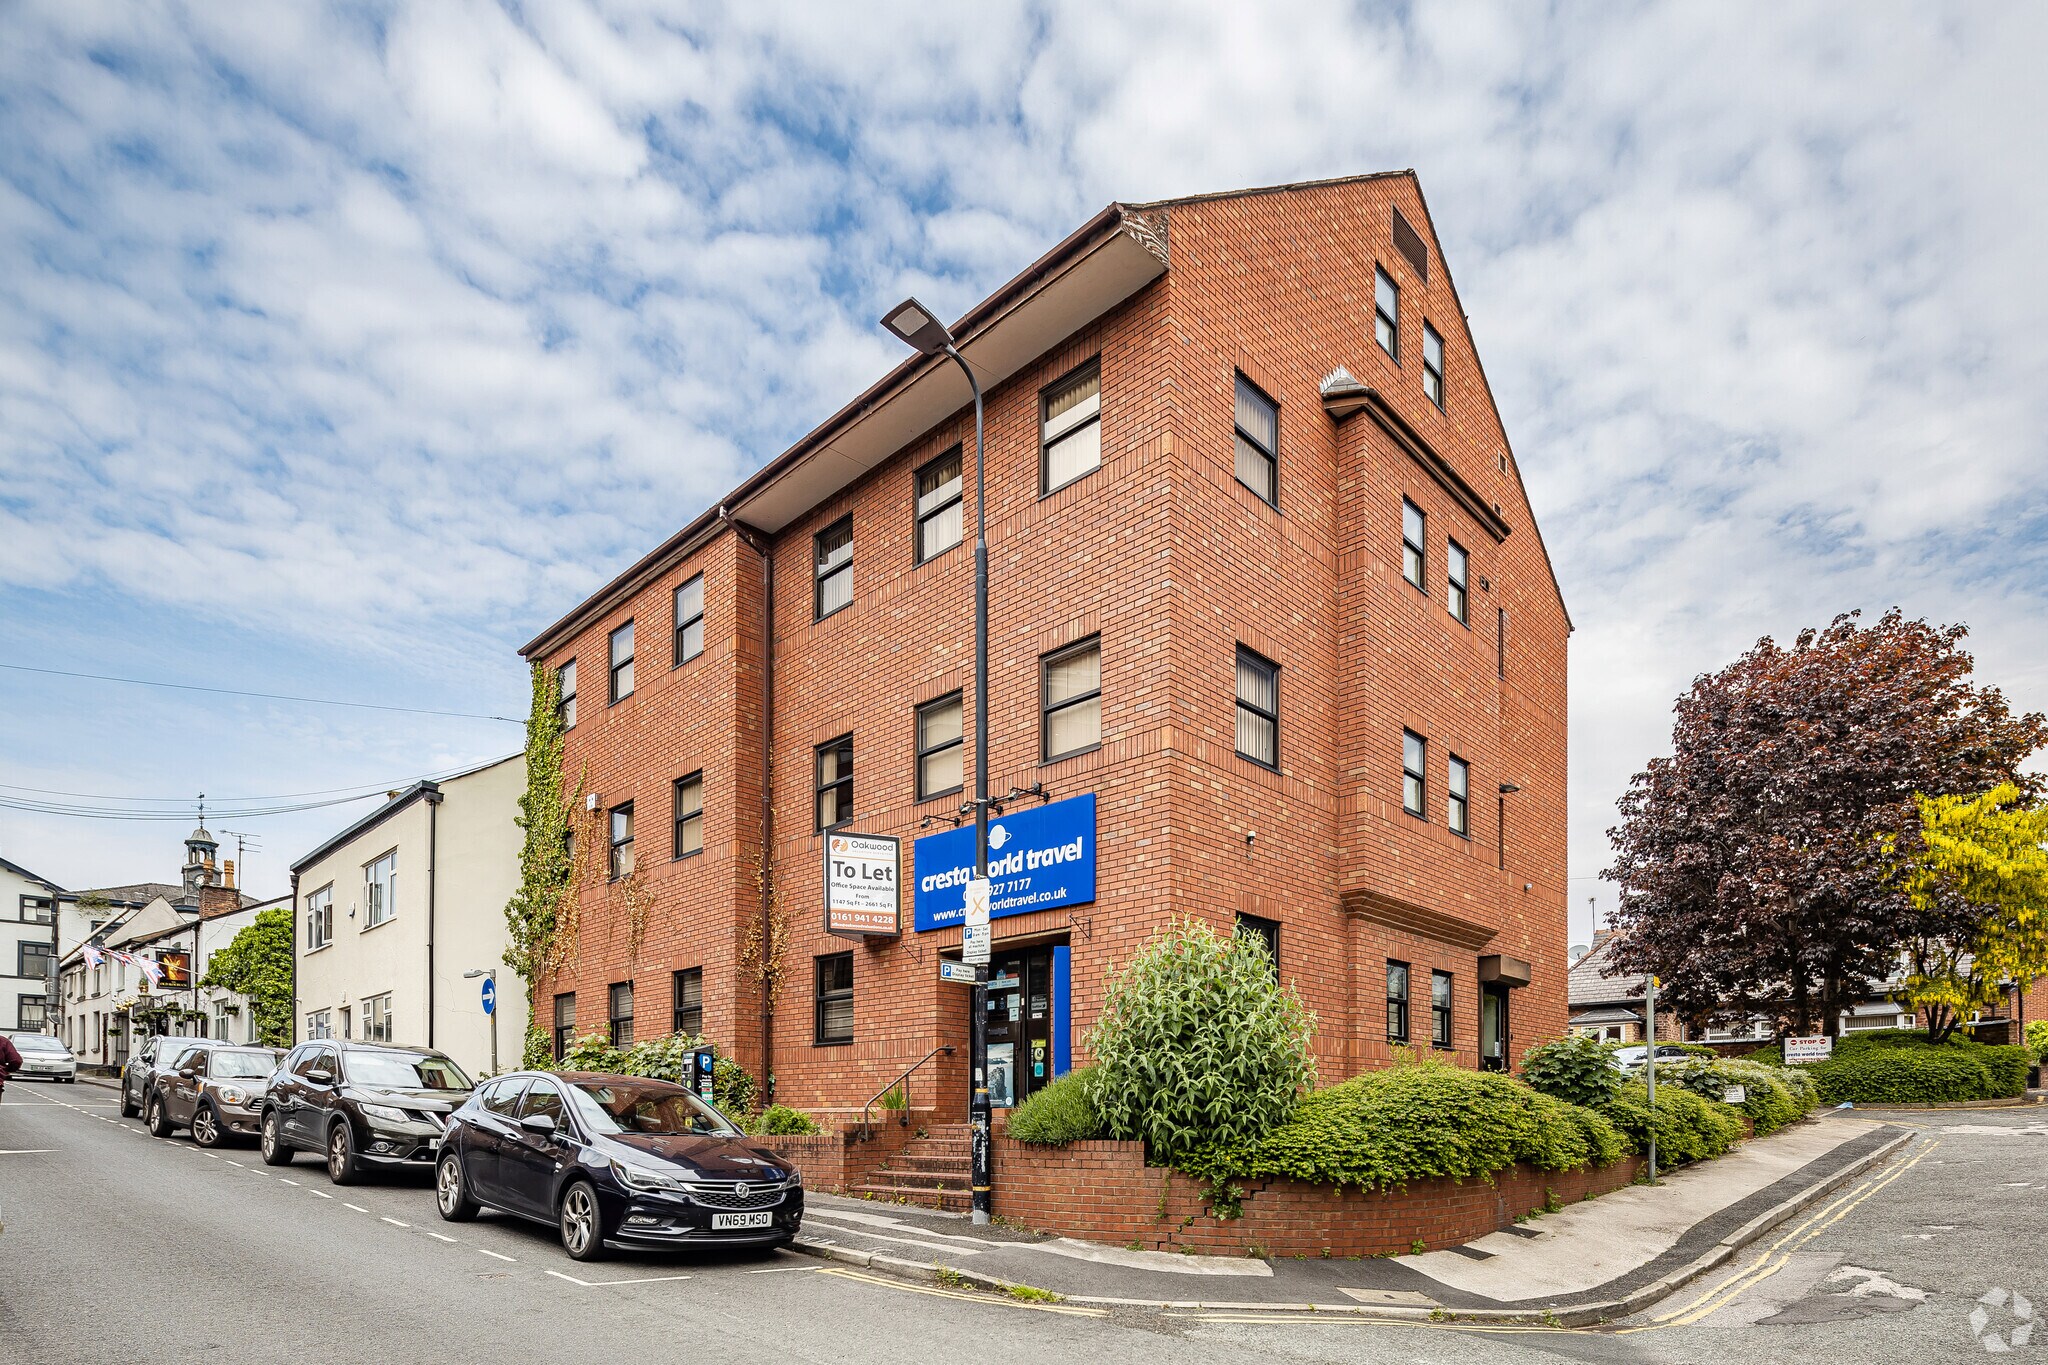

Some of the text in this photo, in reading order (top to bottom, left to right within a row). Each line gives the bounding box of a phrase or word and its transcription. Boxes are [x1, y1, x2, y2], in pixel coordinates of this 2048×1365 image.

[851, 840, 894, 852] Oakwood
[832, 860, 892, 881] To Let
[921, 866, 970, 893] cresta
[1026, 836, 1083, 869] travel
[849, 883, 867, 892] Space
[1007, 877, 1032, 893] 7177
[831, 912, 894, 924] 0161 941 4228
[702, 1055, 710, 1069] P
[718, 1213, 768, 1226] VN69 MSO
